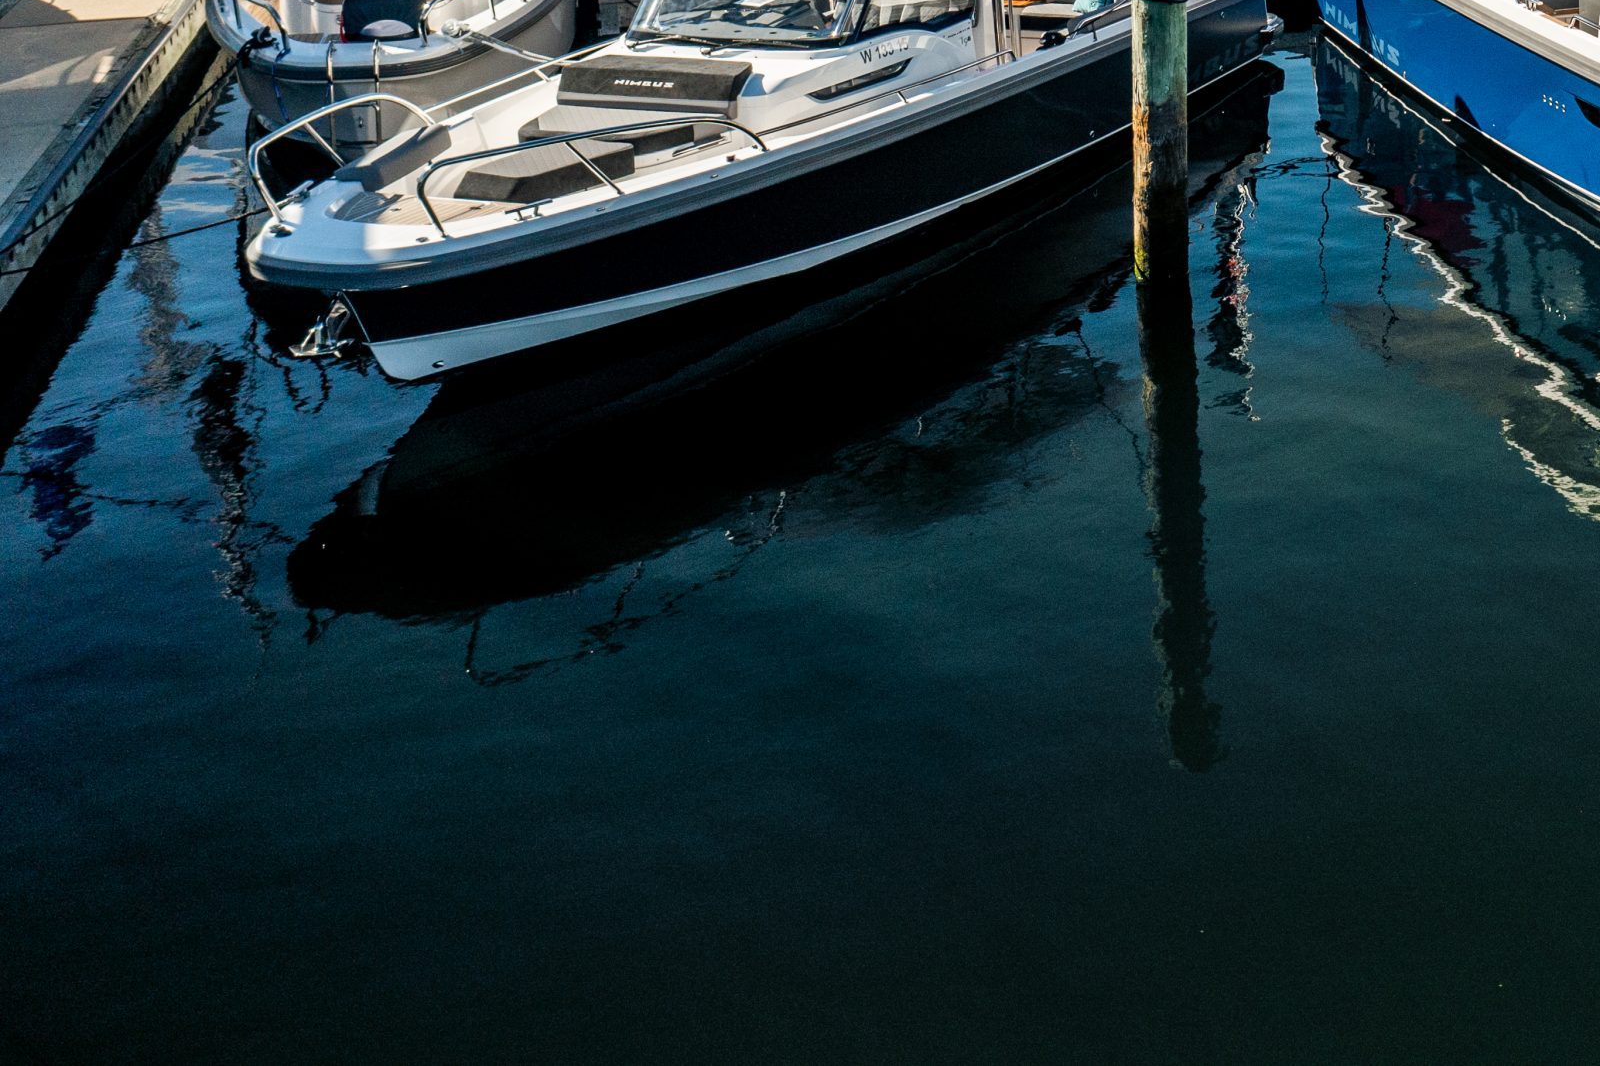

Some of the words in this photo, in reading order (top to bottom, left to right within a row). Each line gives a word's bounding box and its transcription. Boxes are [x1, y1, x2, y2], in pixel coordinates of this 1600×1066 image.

[1325, 0, 1400, 67] NIMUS
[859, 50, 873, 64] W
[875, 42, 896, 60] 133
[614, 78, 675, 89] NIMBUS
